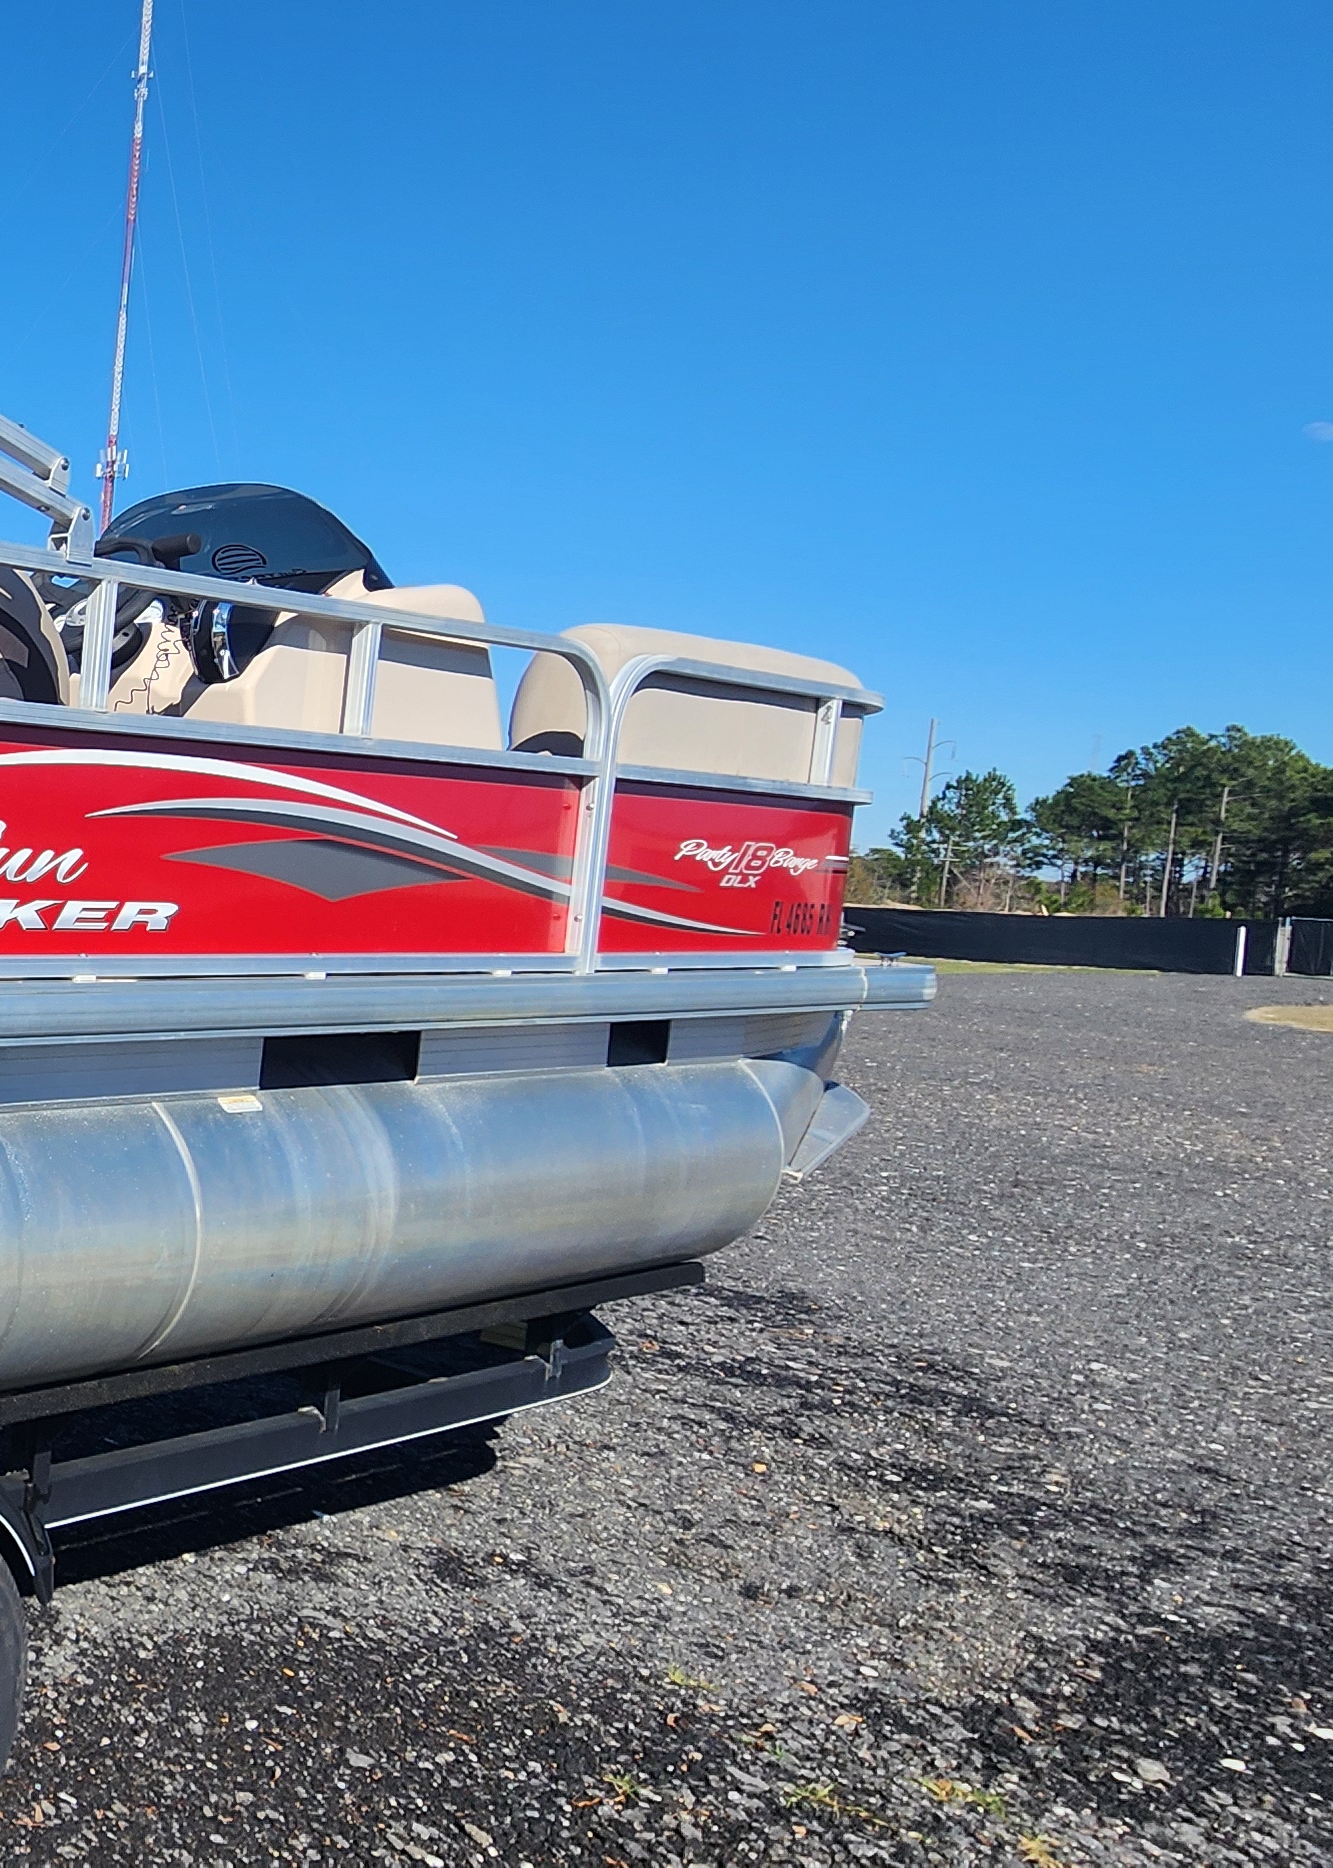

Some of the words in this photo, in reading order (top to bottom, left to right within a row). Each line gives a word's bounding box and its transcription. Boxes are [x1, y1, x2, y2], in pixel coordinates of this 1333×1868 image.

[673, 839, 740, 871] Party
[728, 841, 776, 874] 18
[769, 848, 819, 876] Barge
[719, 874, 762, 888] DLX
[770, 901, 783, 934] FL
